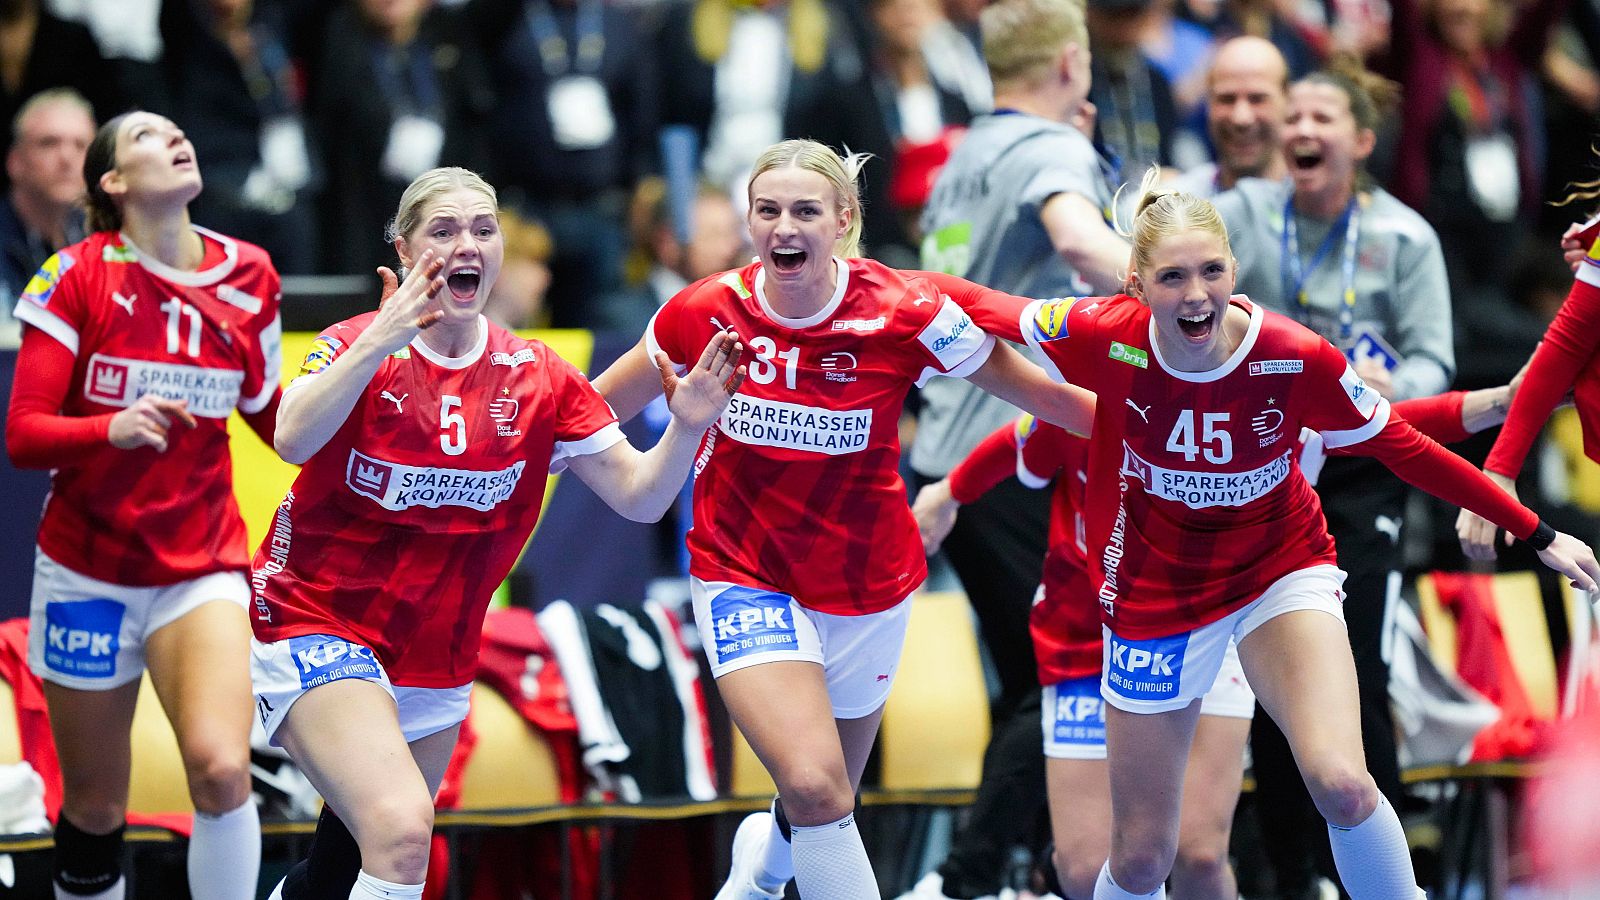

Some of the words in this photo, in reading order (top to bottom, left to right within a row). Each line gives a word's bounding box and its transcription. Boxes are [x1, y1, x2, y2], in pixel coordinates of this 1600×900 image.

[748, 336, 801, 390] 31
[1123, 351, 1148, 368] bring
[439, 394, 467, 456] 5
[728, 398, 868, 432] SPAREKASSEN
[728, 417, 866, 449] KRONJYLLAND
[1166, 409, 1233, 465] 45
[401, 467, 521, 491] SPAREKASSEN
[1163, 463, 1288, 504] KRONJYLLAND
[48, 623, 112, 657] KPK
[717, 607, 789, 640] KPK
[298, 640, 375, 674] KPK
[741, 638, 753, 649] OG
[754, 634, 792, 646] VINDUER
[1112, 640, 1177, 677] KPK
[329, 668, 342, 679] OG
[1123, 678, 1133, 690] OG
[1135, 682, 1173, 693] VINDUER
